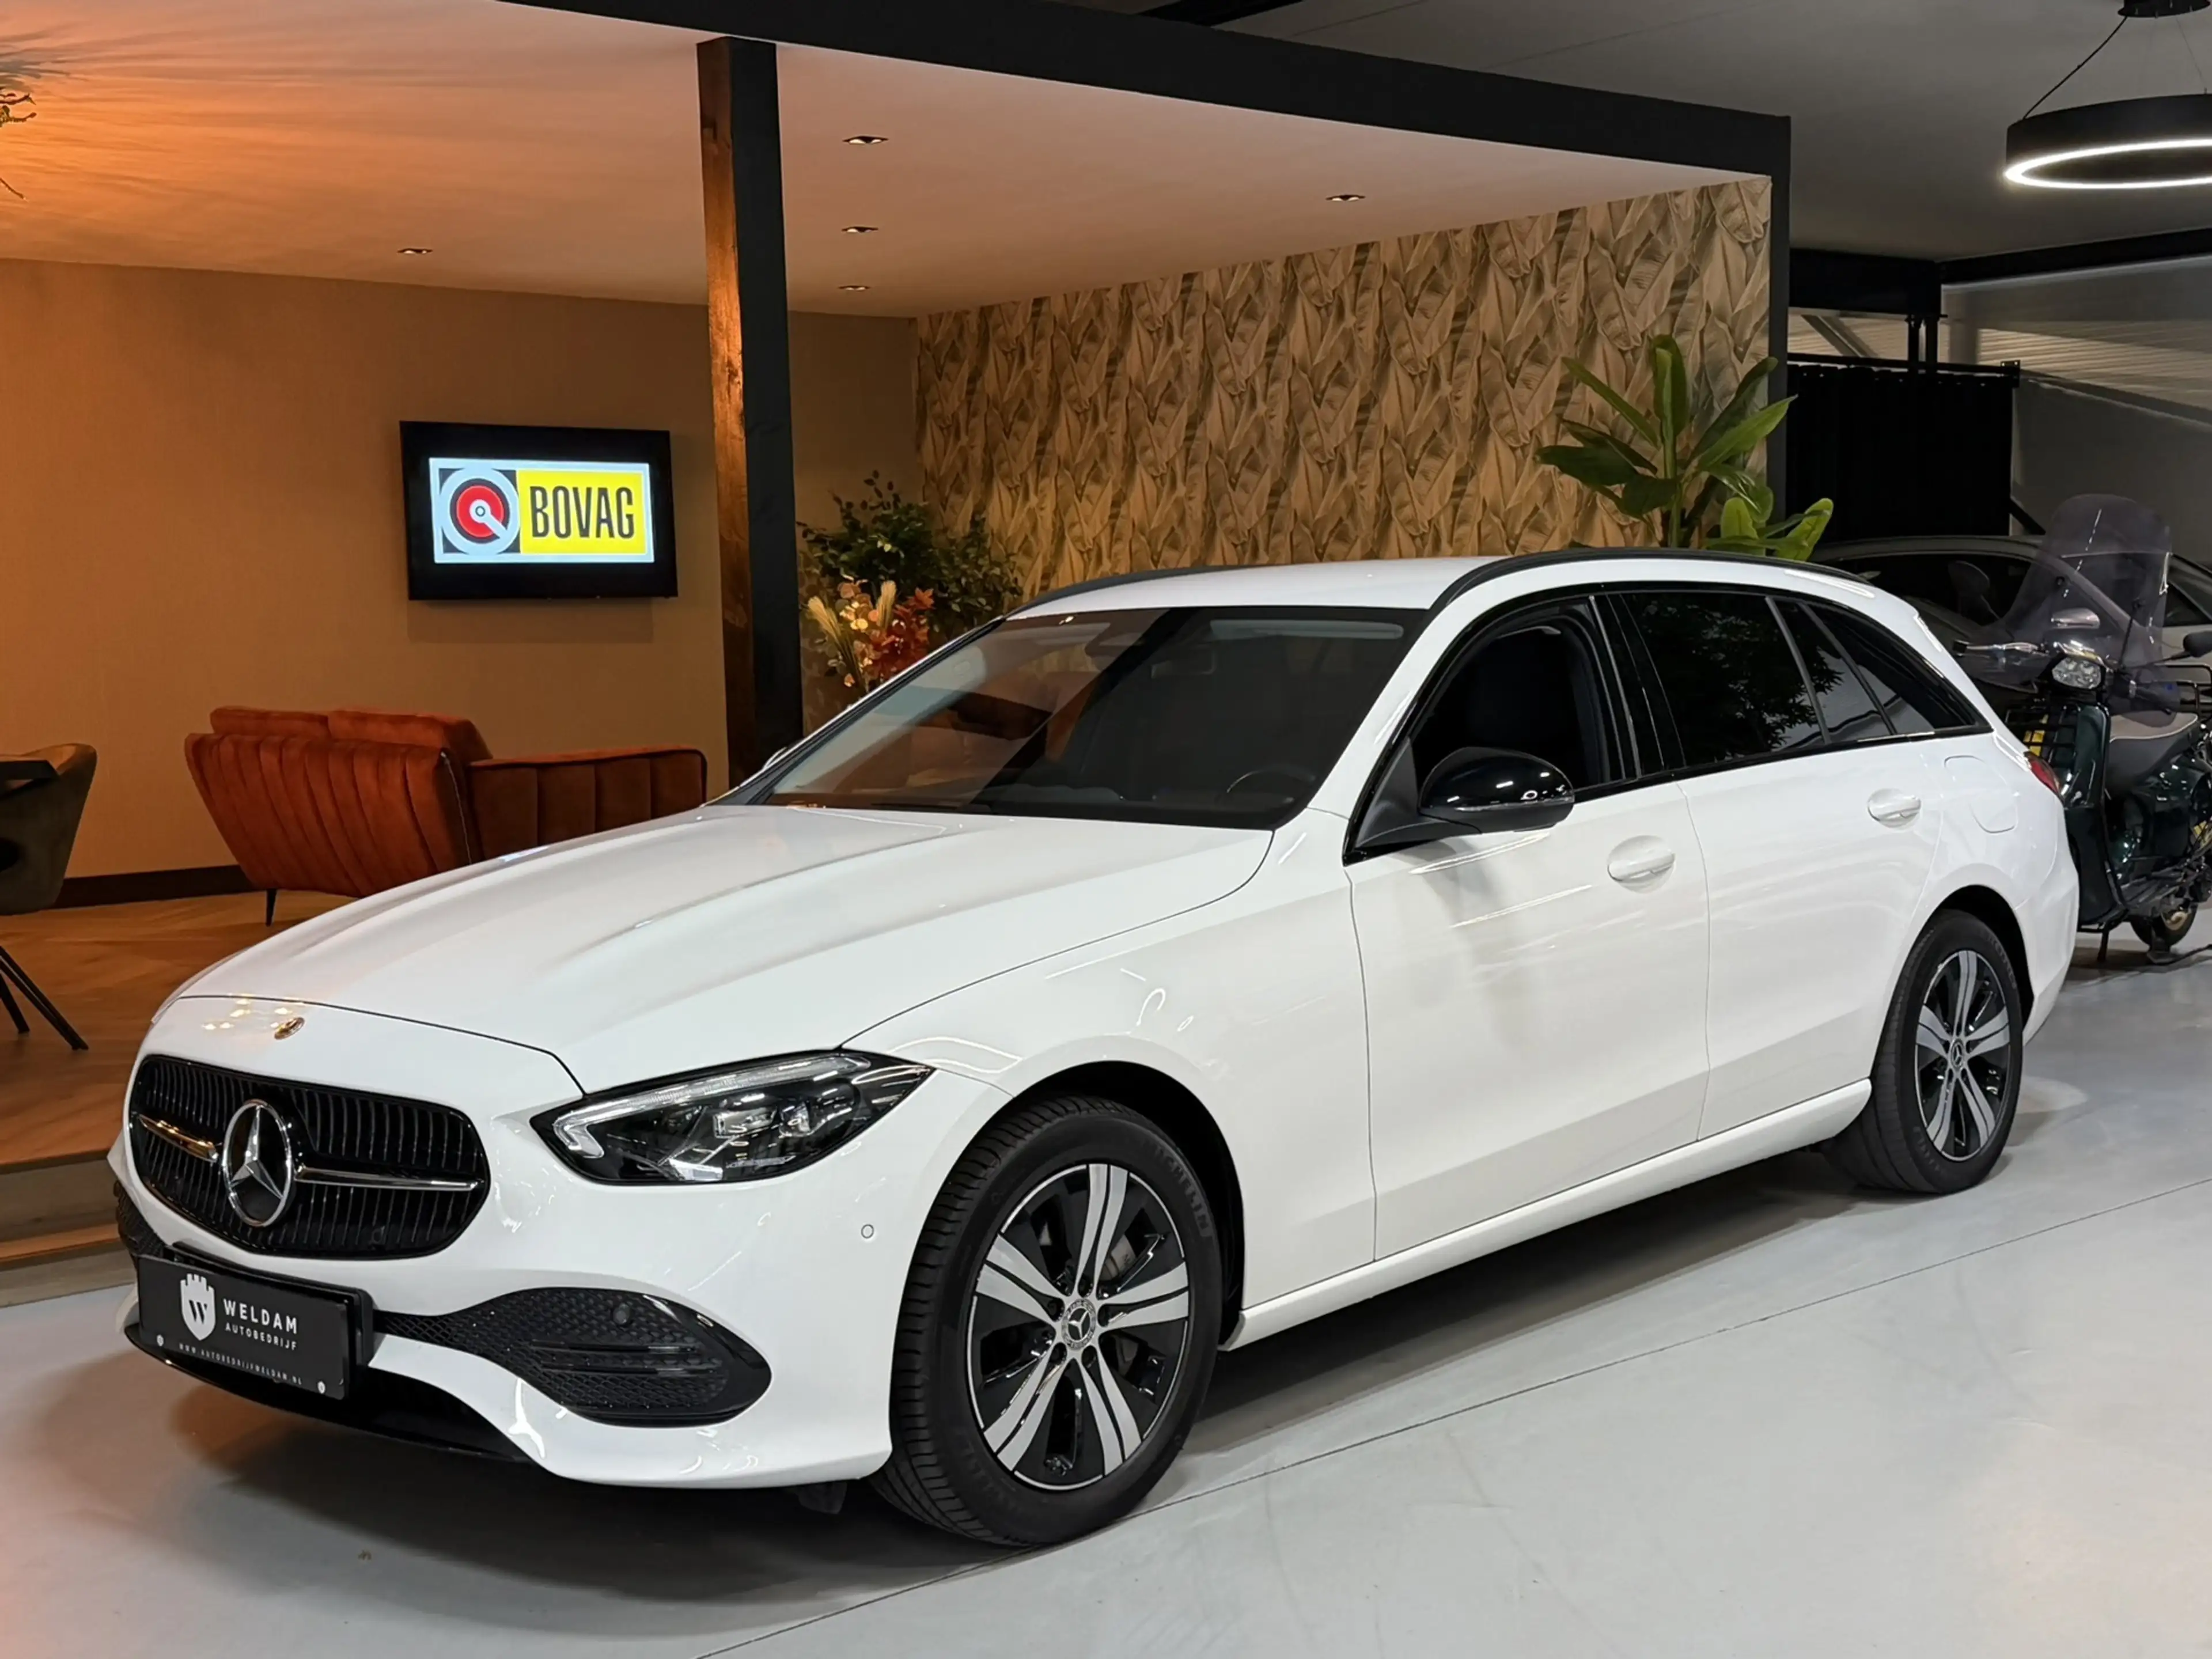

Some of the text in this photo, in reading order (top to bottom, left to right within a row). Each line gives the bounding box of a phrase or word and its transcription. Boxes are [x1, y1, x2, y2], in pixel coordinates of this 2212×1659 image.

[529, 485, 635, 539] BOVAG
[188, 1299, 208, 1325] W
[223, 1298, 298, 1335] WELDAM
[225, 1322, 297, 1351] AUTOBEDRIJF
